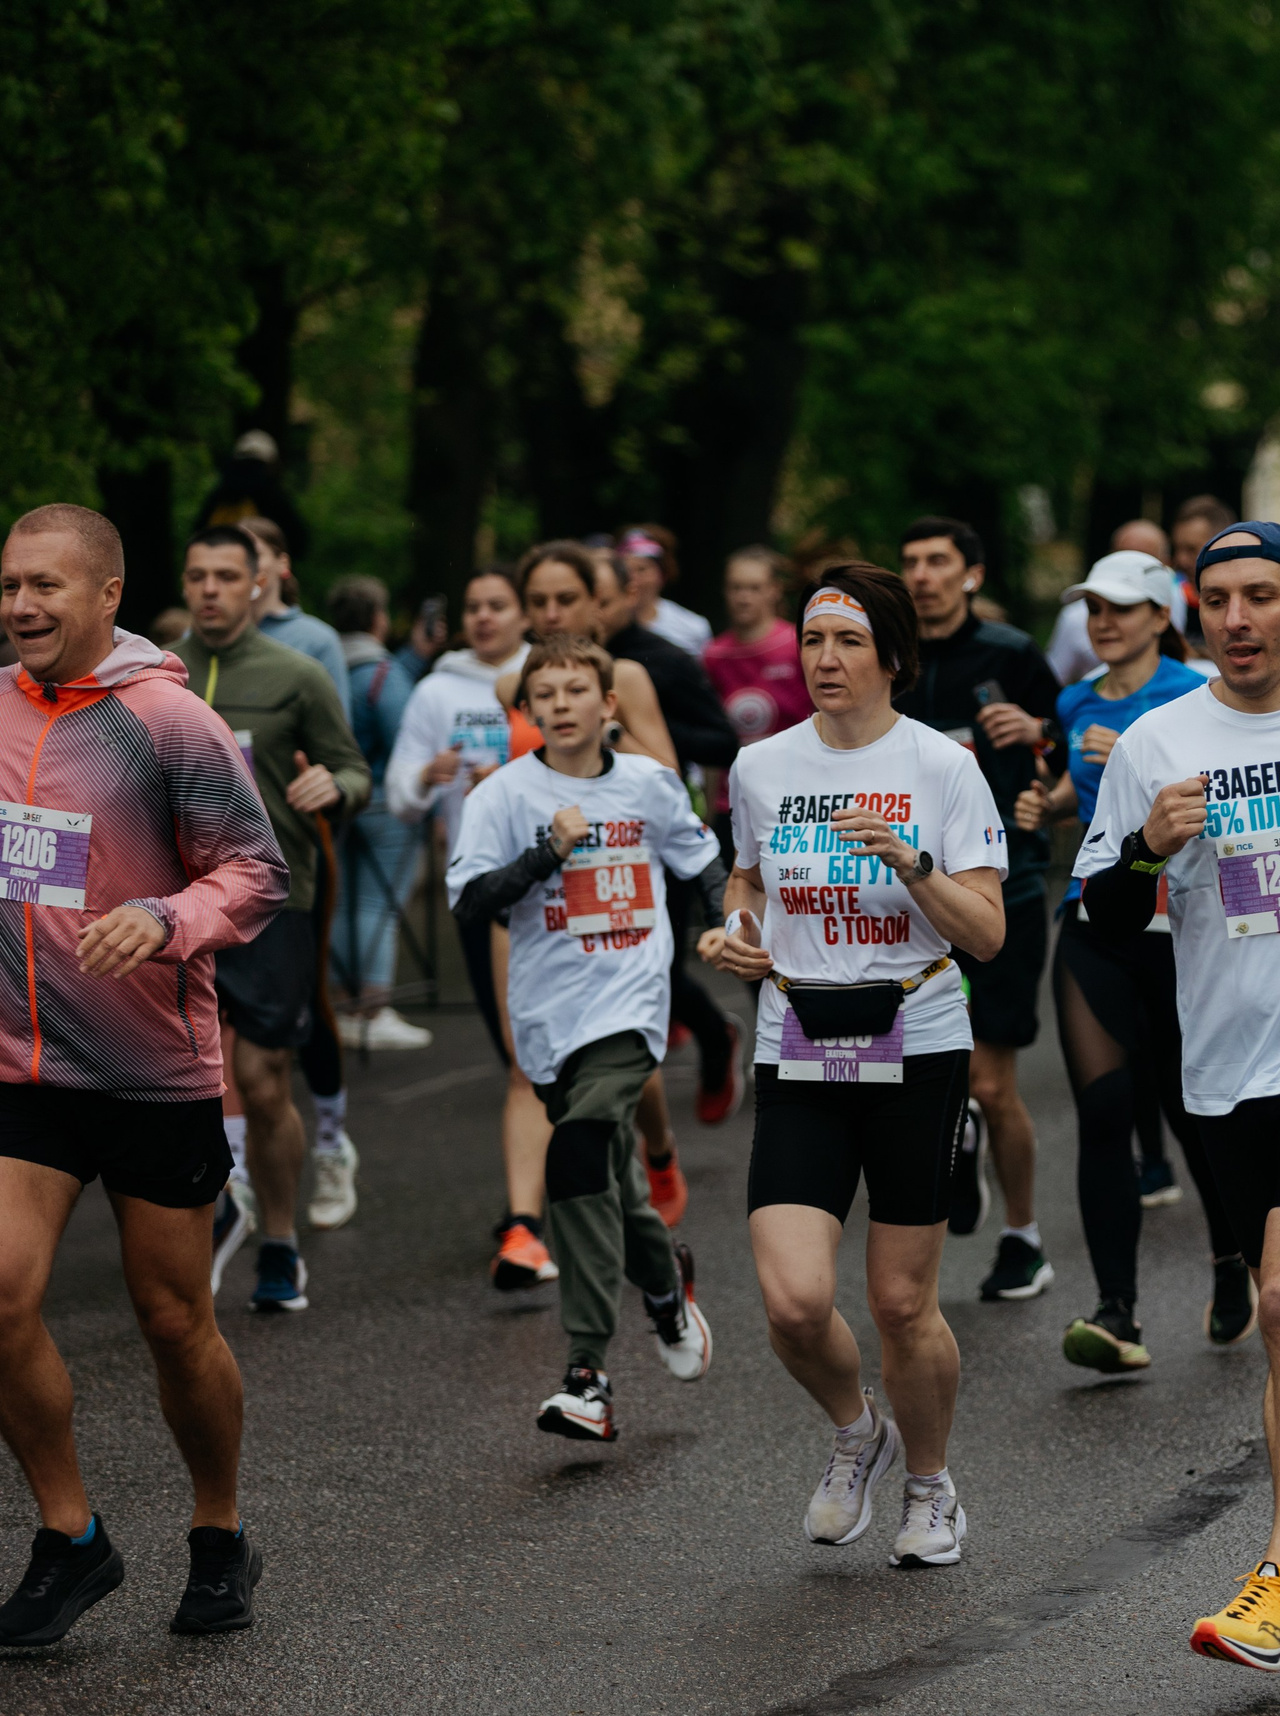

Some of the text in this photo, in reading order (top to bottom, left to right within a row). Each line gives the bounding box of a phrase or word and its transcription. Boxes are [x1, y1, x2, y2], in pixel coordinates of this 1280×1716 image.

[1199, 801, 1245, 840] 5%
[2, 824, 57, 870] 1206
[770, 825, 809, 854] 45%
[1236, 843, 1254, 852] ПСБ
[594, 865, 637, 902] 848
[779, 886, 861, 915] ВМЕСТЕ
[824, 911, 910, 945] С ТОБОЙ
